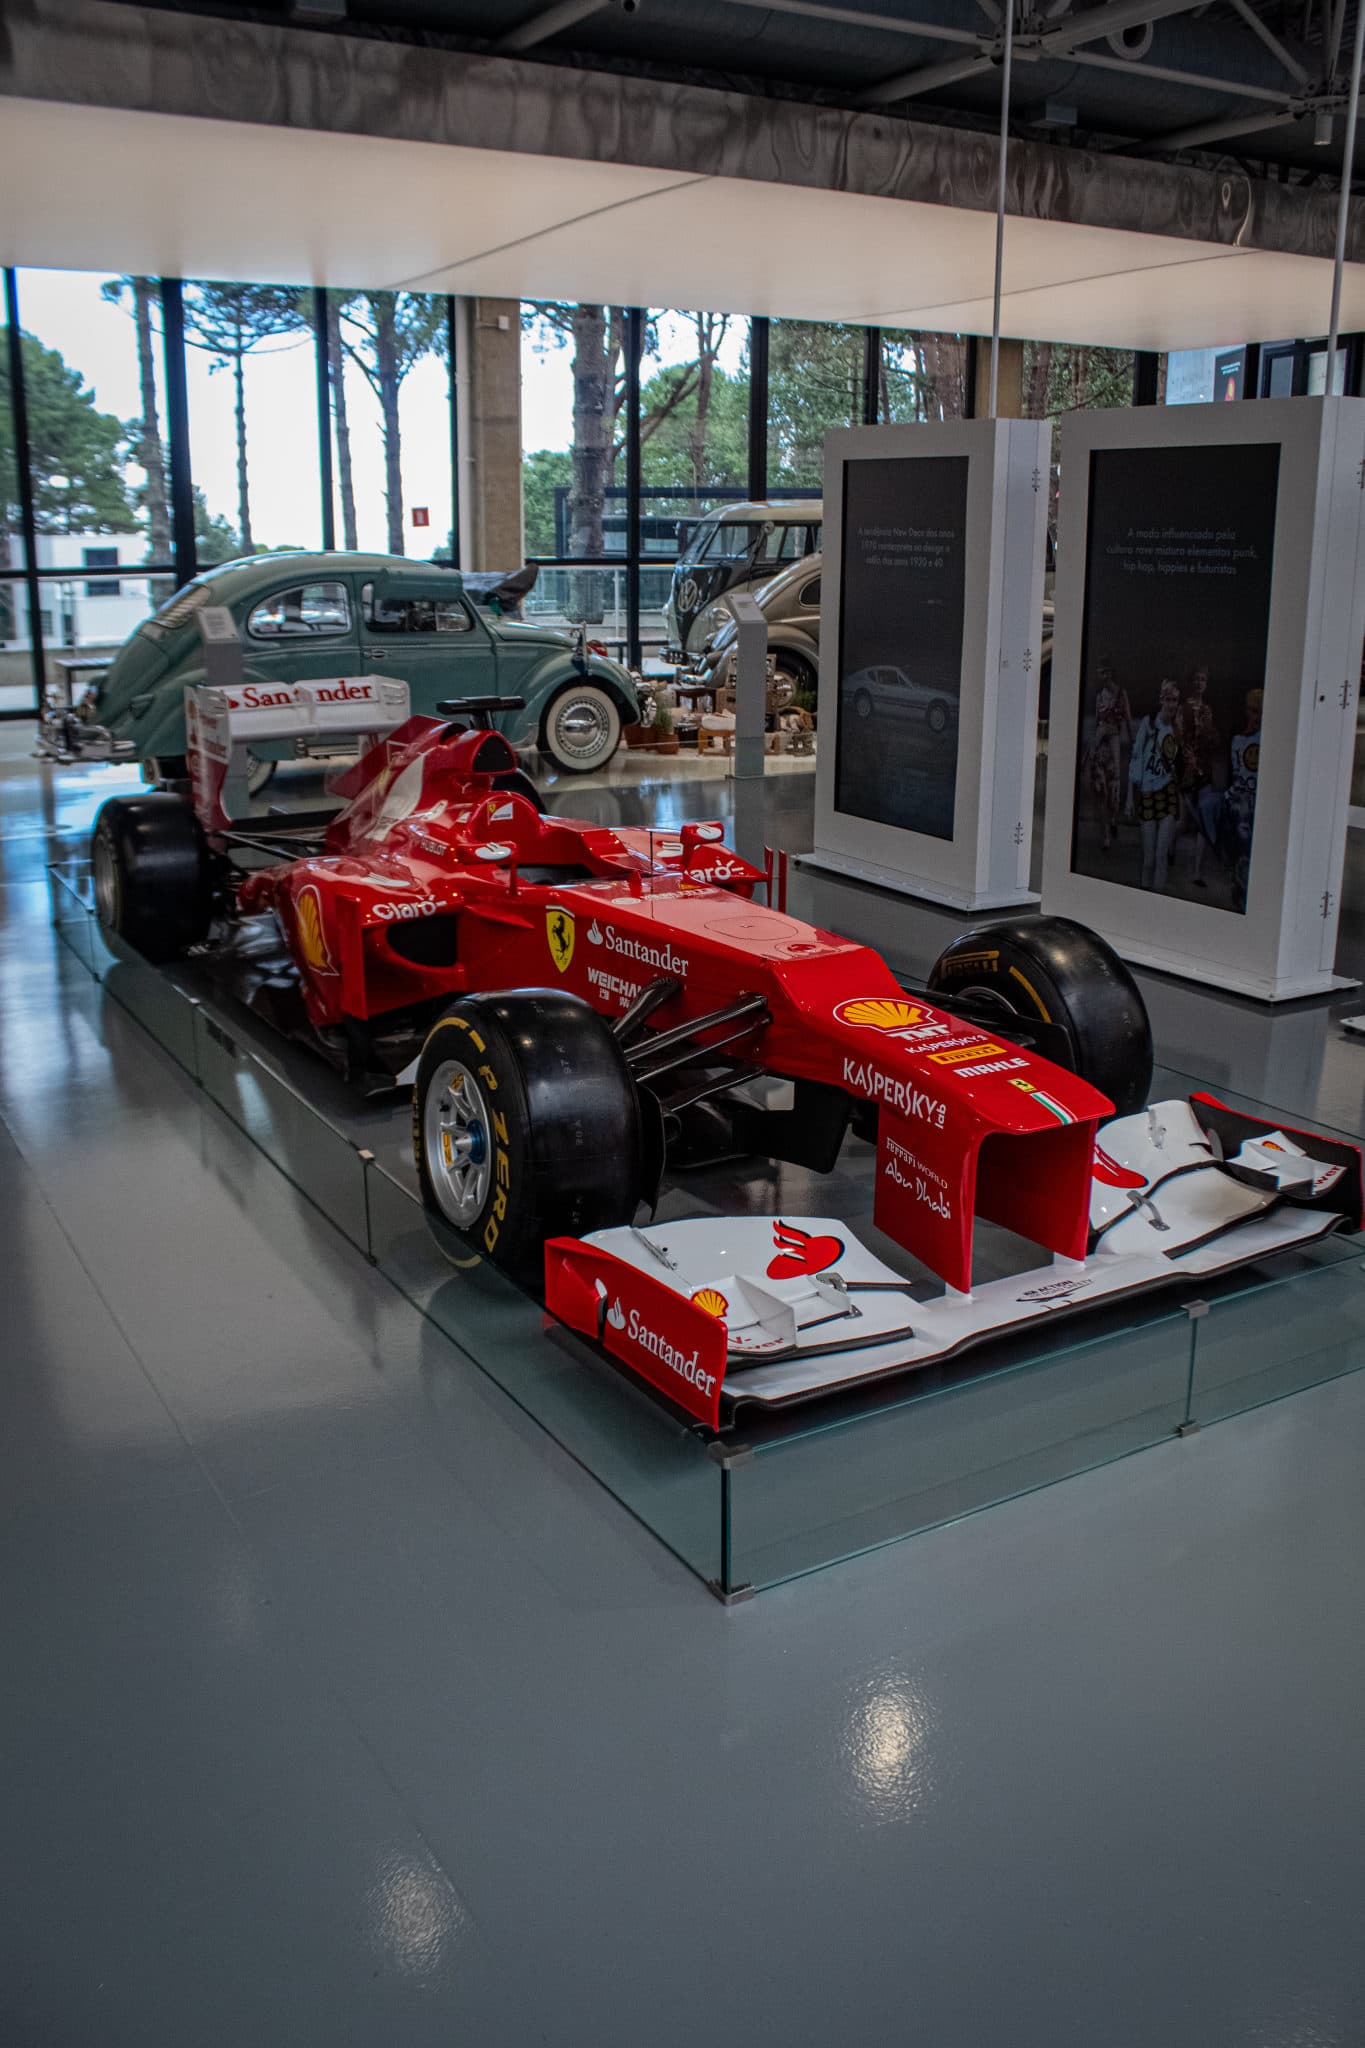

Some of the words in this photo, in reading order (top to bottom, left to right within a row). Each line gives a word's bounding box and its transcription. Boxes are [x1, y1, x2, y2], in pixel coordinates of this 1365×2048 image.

[242, 680, 372, 708] Sannder
[605, 925, 689, 977] Santander
[887, 1023, 951, 1041] TNT
[904, 1035, 979, 1055] KASPERSKY
[936, 1045, 999, 1063] PIRELLI
[952, 1057, 1031, 1078] MAHLE
[843, 1057, 938, 1123] KASPERSKY
[483, 1110, 511, 1254] ZERO
[884, 1157, 913, 1189] Abu
[915, 1176, 951, 1219] Dhabi
[917, 1161, 948, 1189] WORLD
[627, 1309, 717, 1398] Santander
